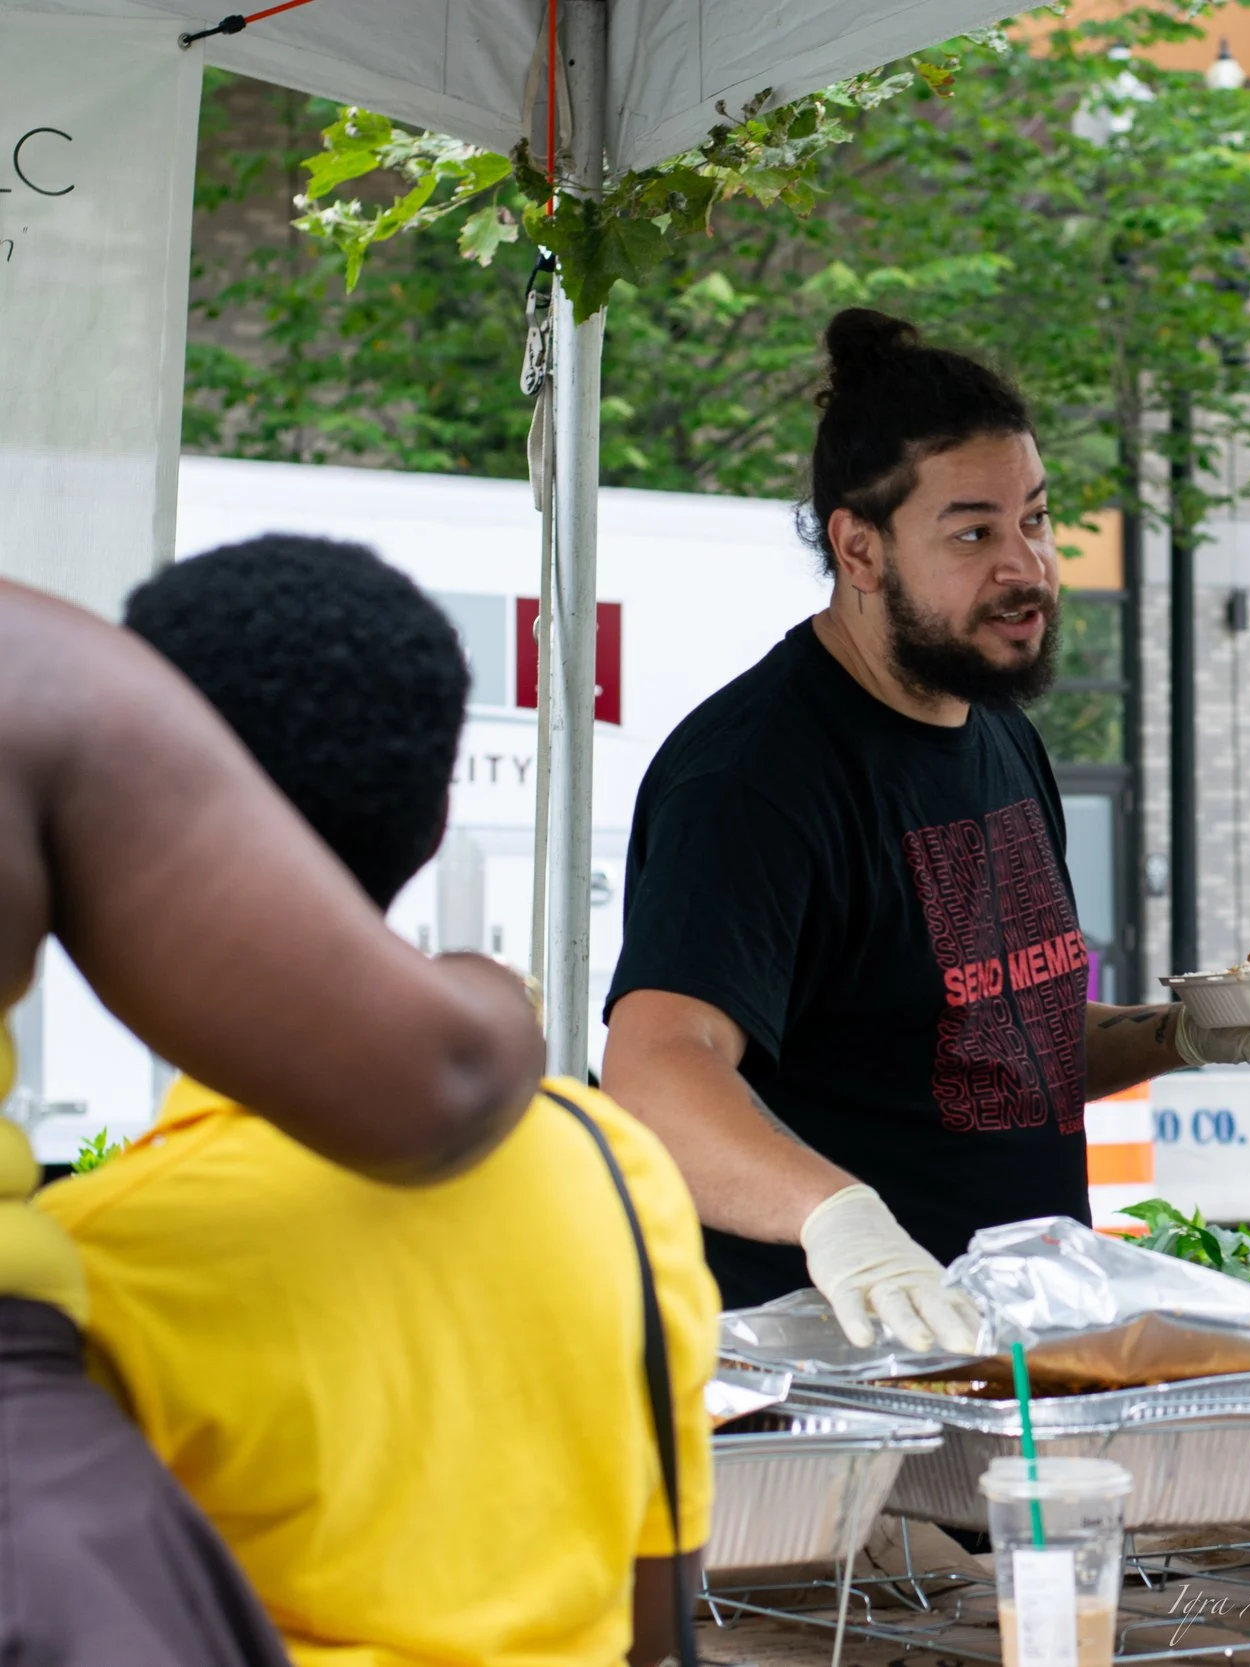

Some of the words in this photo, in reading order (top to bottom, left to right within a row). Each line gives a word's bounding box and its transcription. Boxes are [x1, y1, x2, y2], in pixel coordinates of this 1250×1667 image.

[0, 127, 75, 196] C
[450, 753, 533, 784] ITY
[902, 819, 986, 868] SEND
[944, 958, 1004, 1007] SEND
[1008, 929, 1089, 991] MEMES
[936, 1025, 1027, 1070] SEND
[932, 1056, 1039, 1101] SEND
[940, 1089, 1048, 1132] SEND
[1152, 1108, 1180, 1143] O
[1191, 1108, 1247, 1145] CO.
